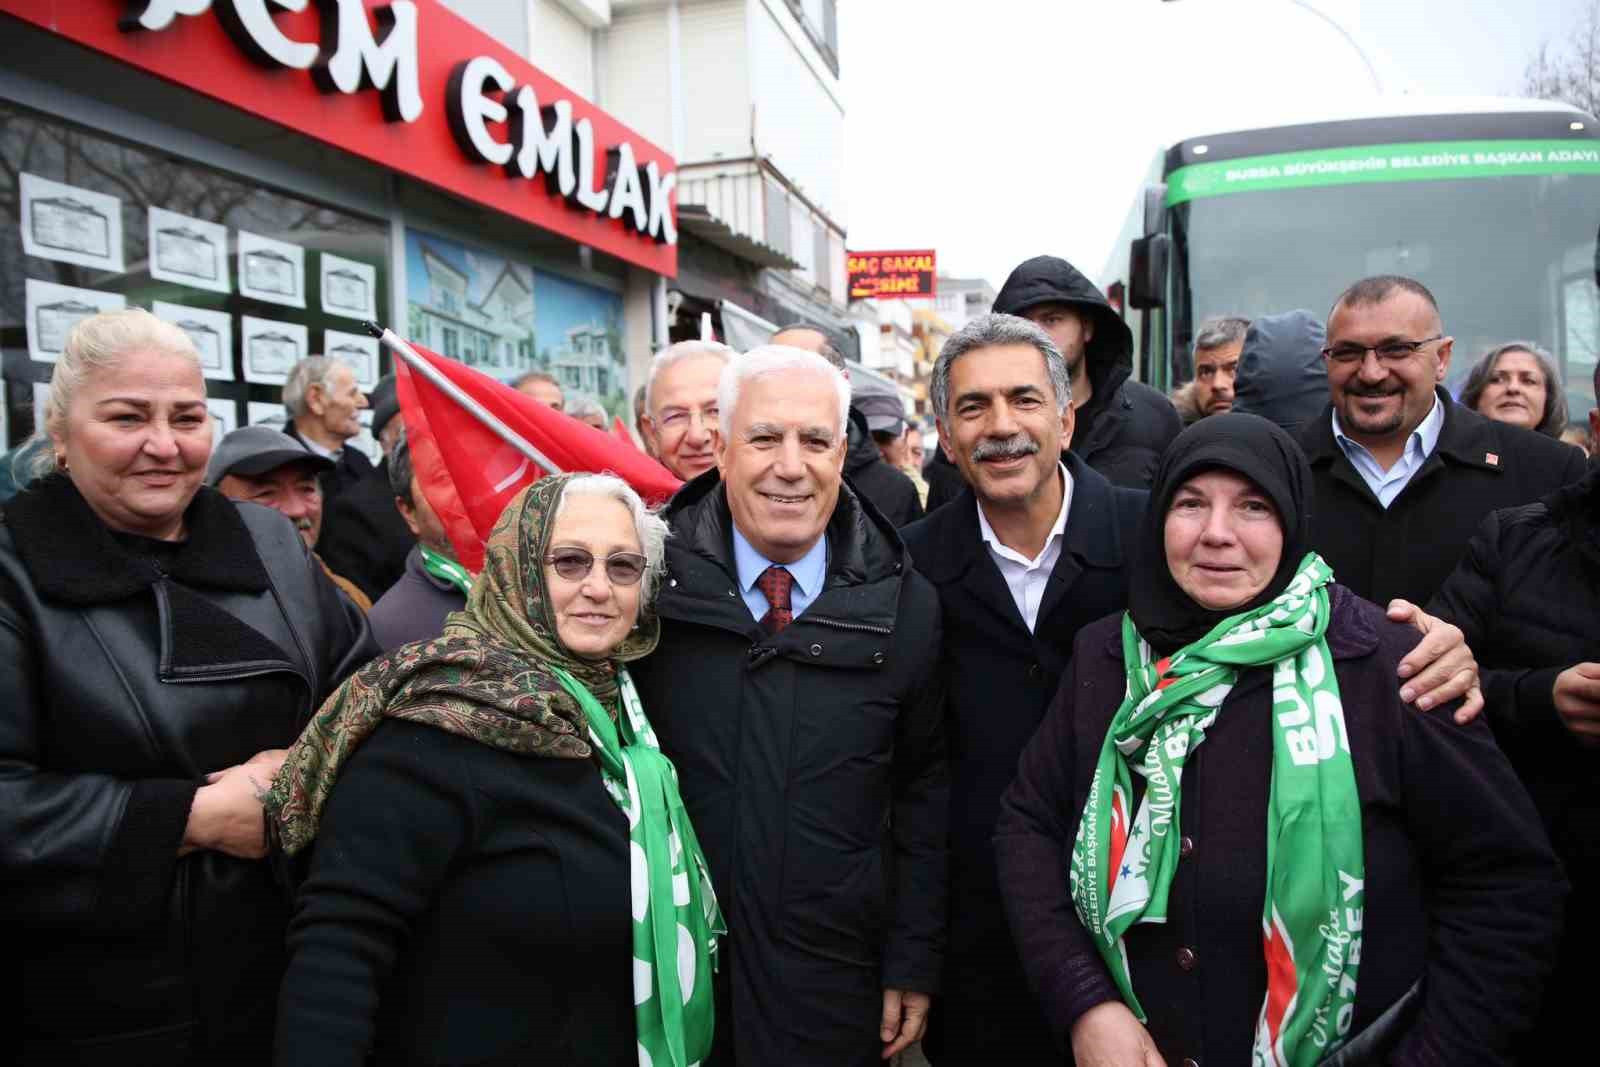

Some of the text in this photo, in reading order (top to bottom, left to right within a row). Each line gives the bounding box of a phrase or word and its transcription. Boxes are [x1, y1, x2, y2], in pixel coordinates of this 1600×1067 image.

[139, 0, 678, 245] EM EMLAK
[1391, 152, 1470, 168] BELEDİYE
[1474, 151, 1543, 166] BAŞKAN
[1547, 150, 1599, 162] ADAYI
[1087, 769, 1102, 934] BELEDİYE BAŞKAN ADAYI
[1331, 869, 1364, 1048] OZBEY
